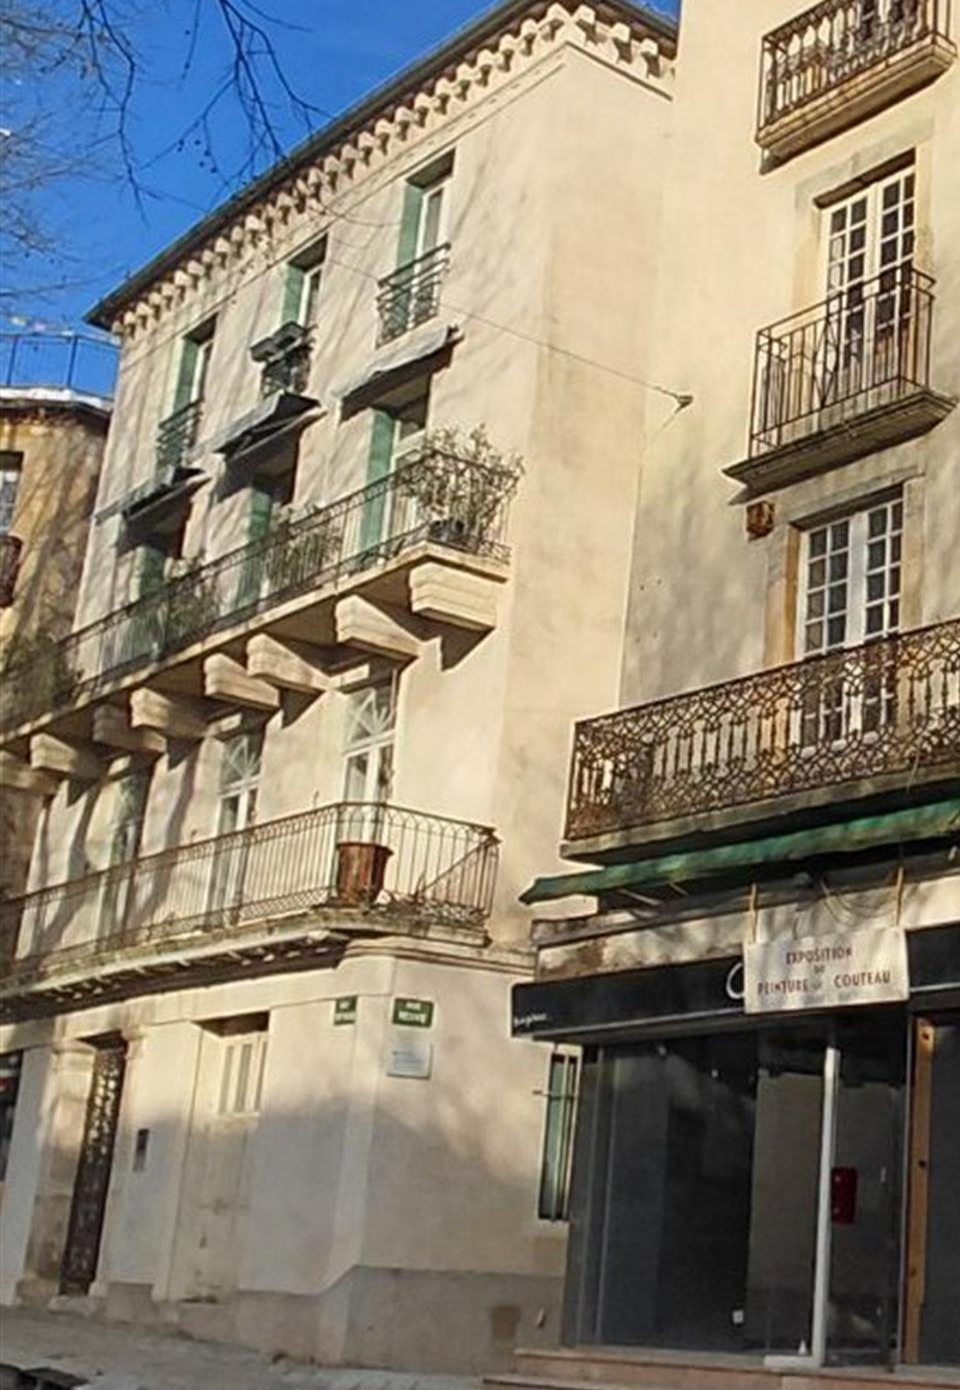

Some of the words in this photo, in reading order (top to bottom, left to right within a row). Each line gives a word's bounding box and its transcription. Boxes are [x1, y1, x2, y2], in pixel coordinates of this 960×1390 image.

[787, 947, 852, 964] EXPOSITION
[758, 979, 809, 995] PEINTURE
[834, 972, 891, 988] COUTEAU
